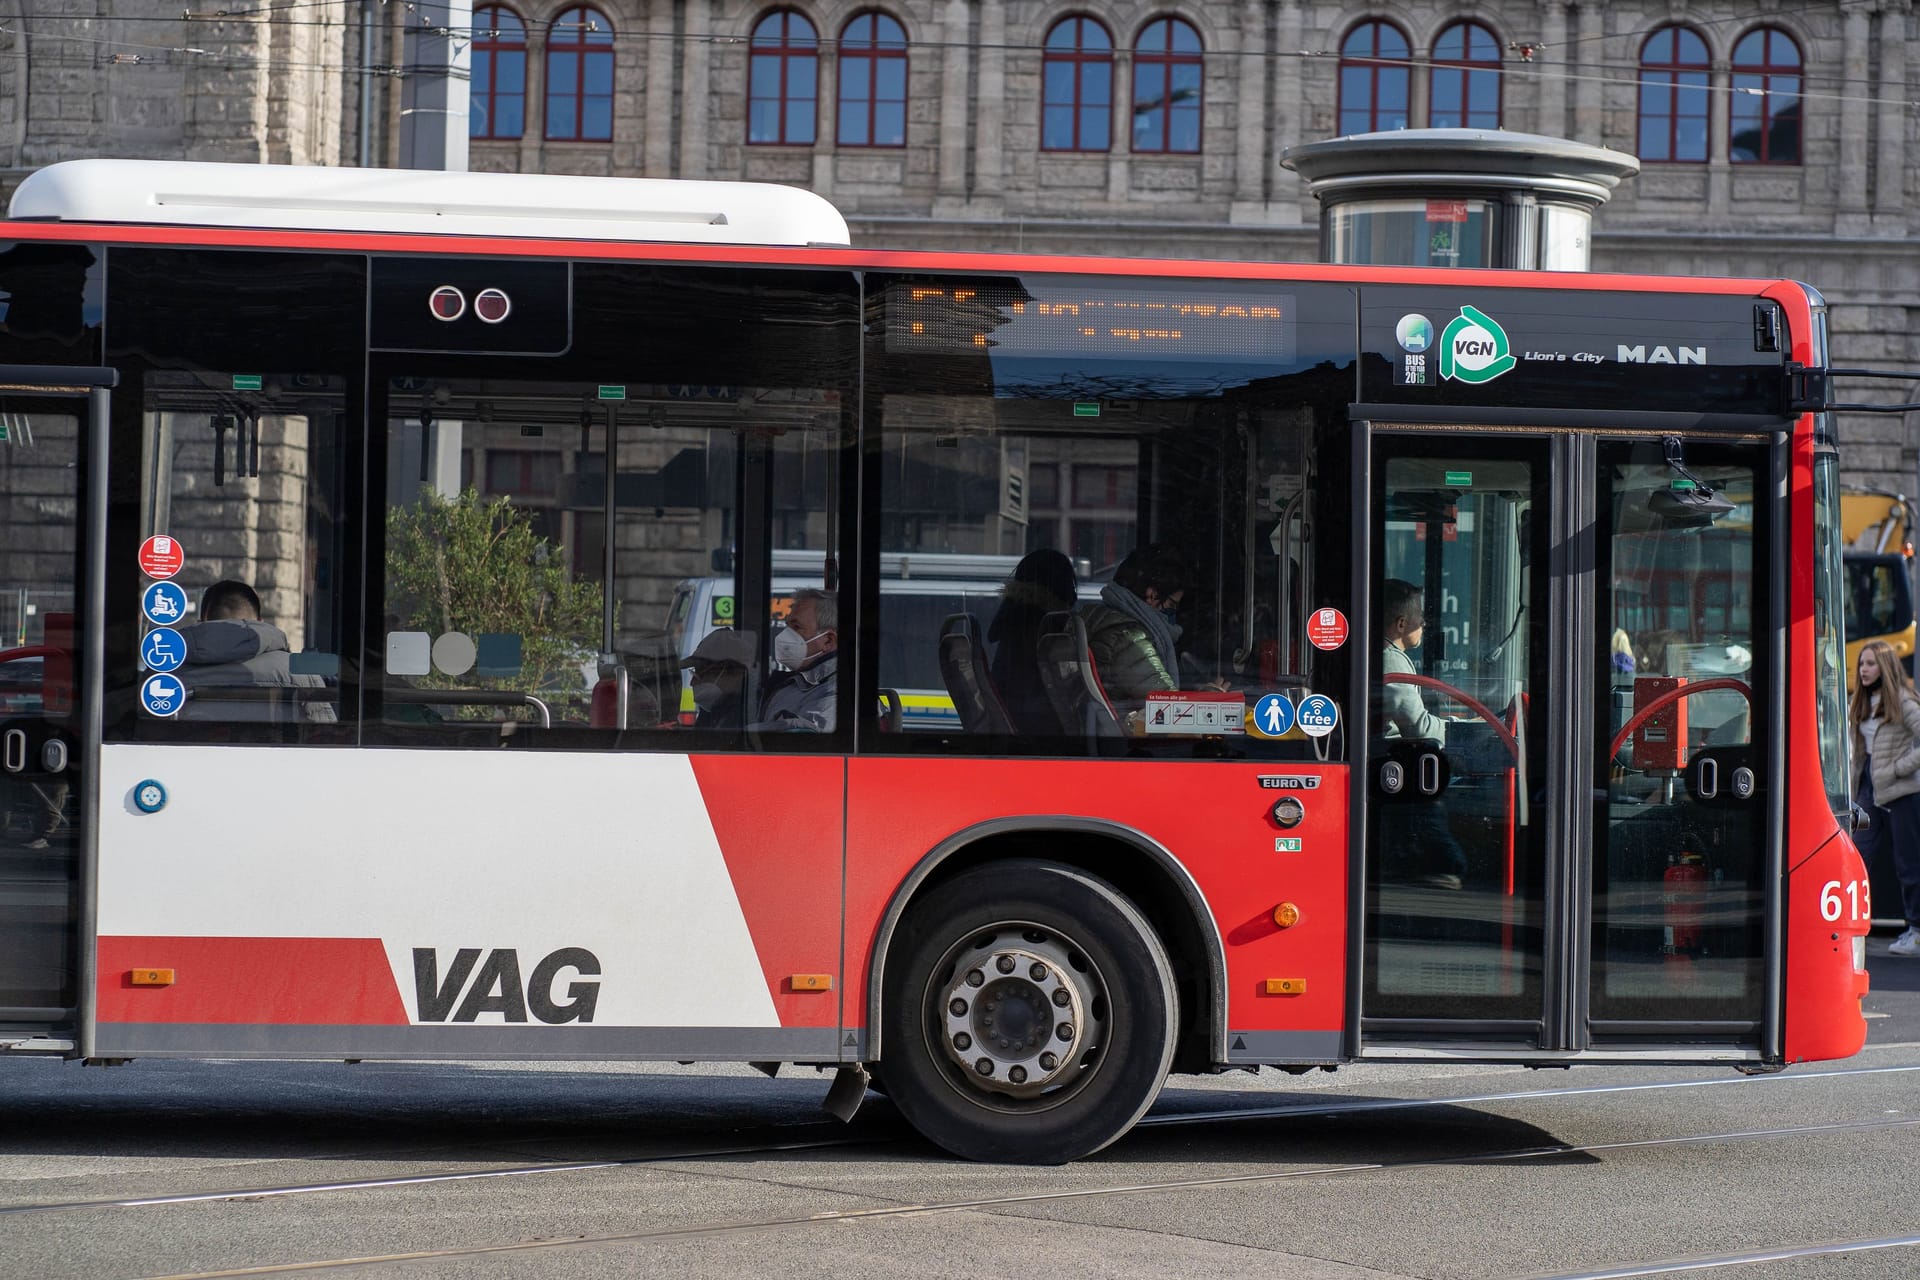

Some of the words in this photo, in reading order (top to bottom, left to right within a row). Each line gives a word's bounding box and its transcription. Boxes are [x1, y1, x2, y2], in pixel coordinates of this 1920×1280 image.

[1455, 341, 1493, 356] VGN
[1617, 344, 1707, 366] MAN
[1405, 354, 1425, 366] BUS
[1524, 351, 1567, 362] Lion's
[1572, 352, 1605, 364] City
[1405, 372, 1425, 384] 2015
[722, 601, 731, 614] 3
[1303, 711, 1332, 725] free
[1263, 778, 1298, 788] EURO
[1305, 777, 1316, 788] 6
[1820, 880, 1871, 922] 613
[411, 946, 601, 1024] VAG
